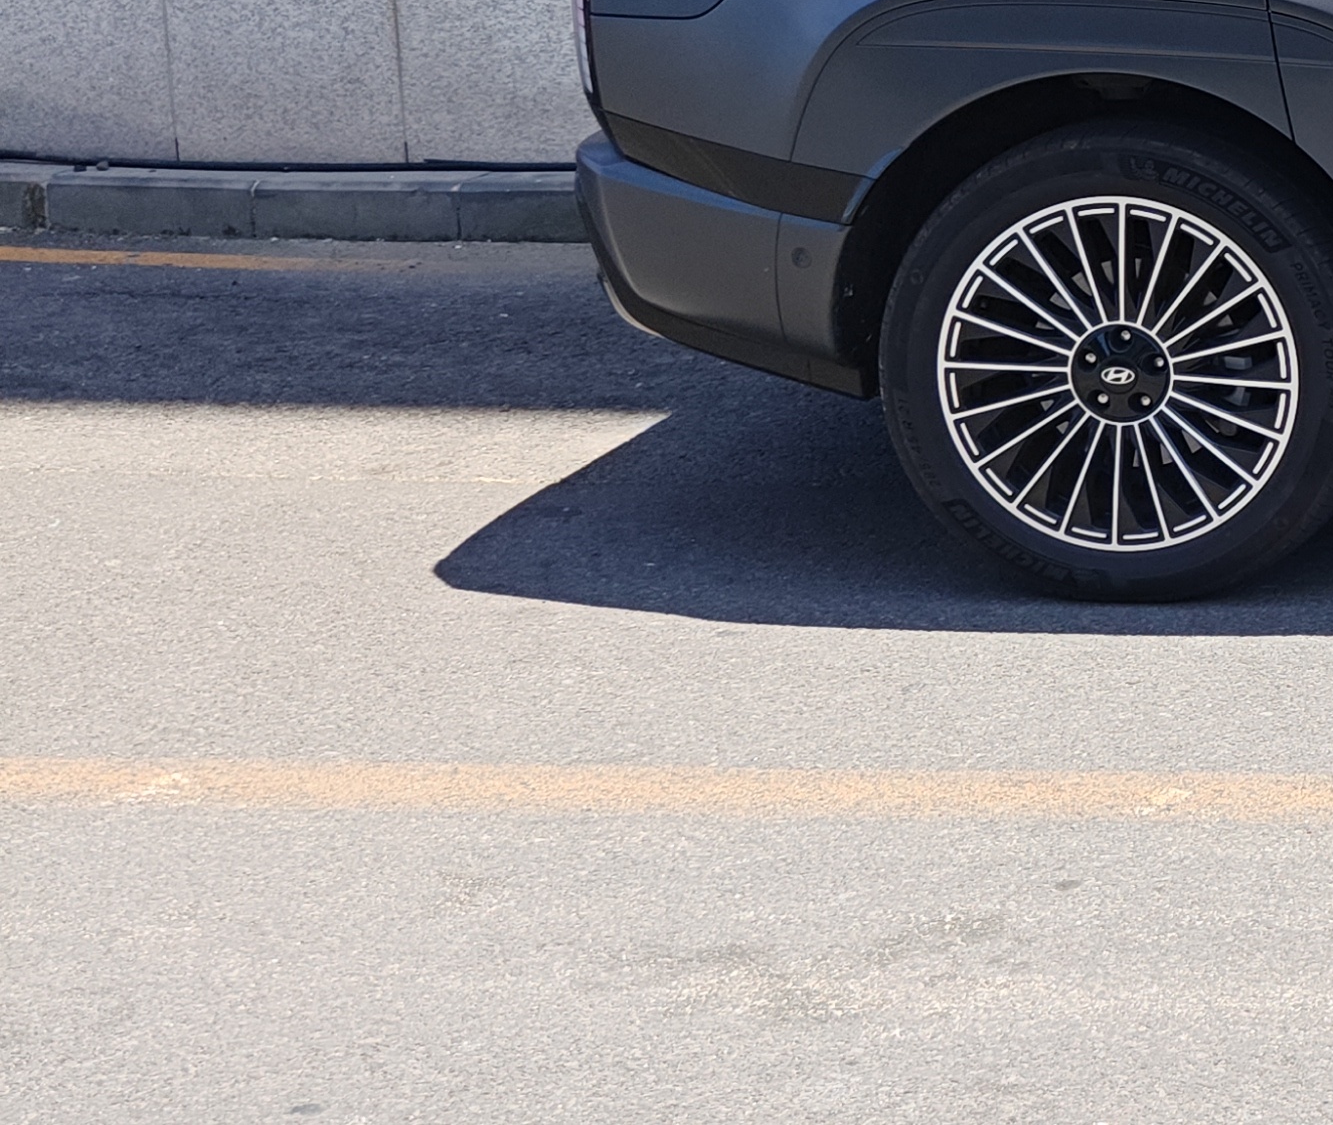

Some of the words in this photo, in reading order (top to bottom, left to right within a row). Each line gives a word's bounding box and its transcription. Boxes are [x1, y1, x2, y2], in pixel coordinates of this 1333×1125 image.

[1162, 167, 1284, 250] MICHELIN
[1291, 261, 1331, 330] PRIMACY
[947, 503, 1068, 581] MICHELIN
